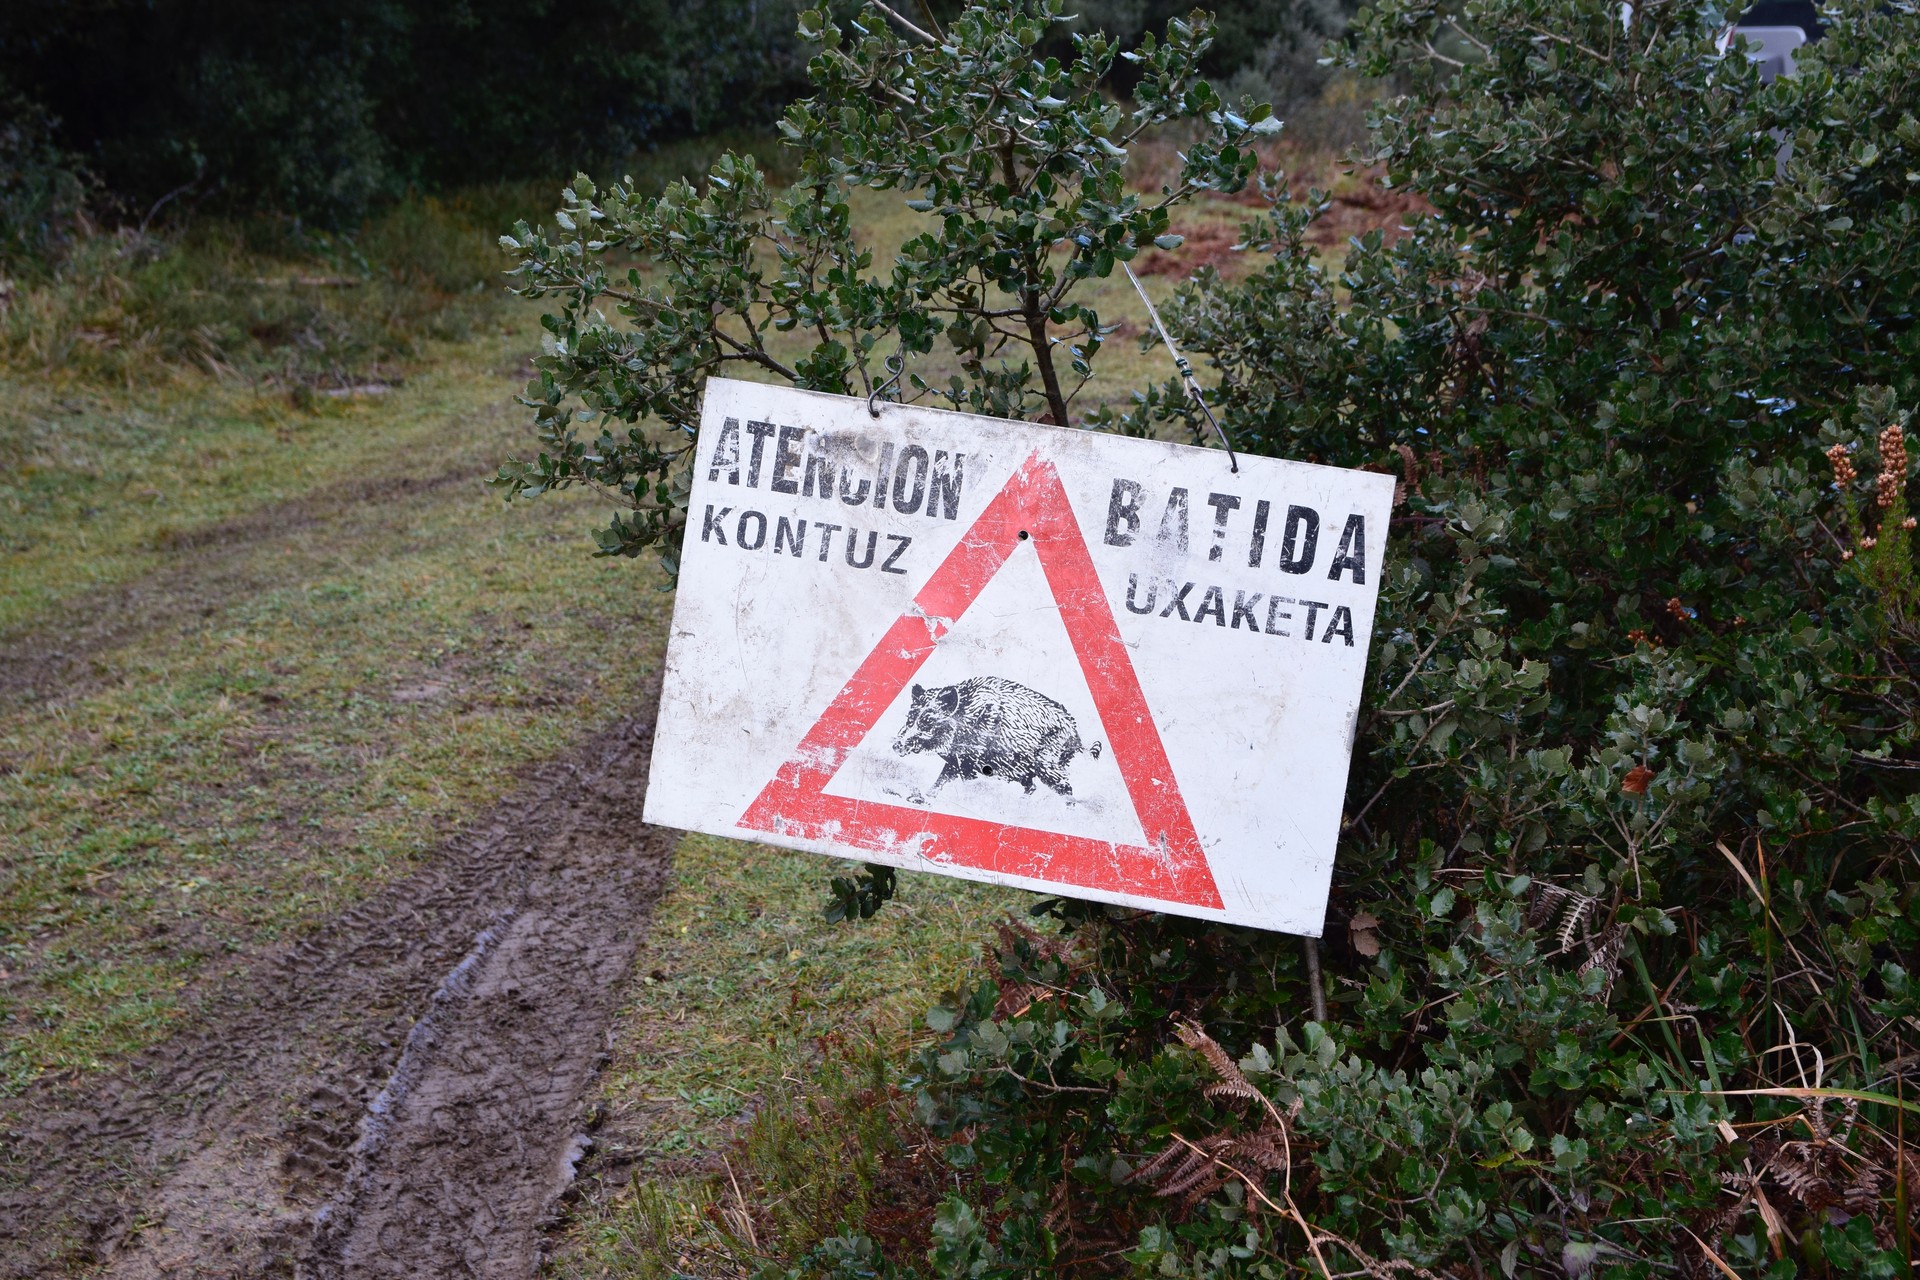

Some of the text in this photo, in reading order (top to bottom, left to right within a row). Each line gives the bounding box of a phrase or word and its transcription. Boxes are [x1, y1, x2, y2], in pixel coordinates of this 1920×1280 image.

[701, 504, 1355, 647] KONTUZ UXAKETA
[708, 416, 1366, 585] ATENCION BATIDA
